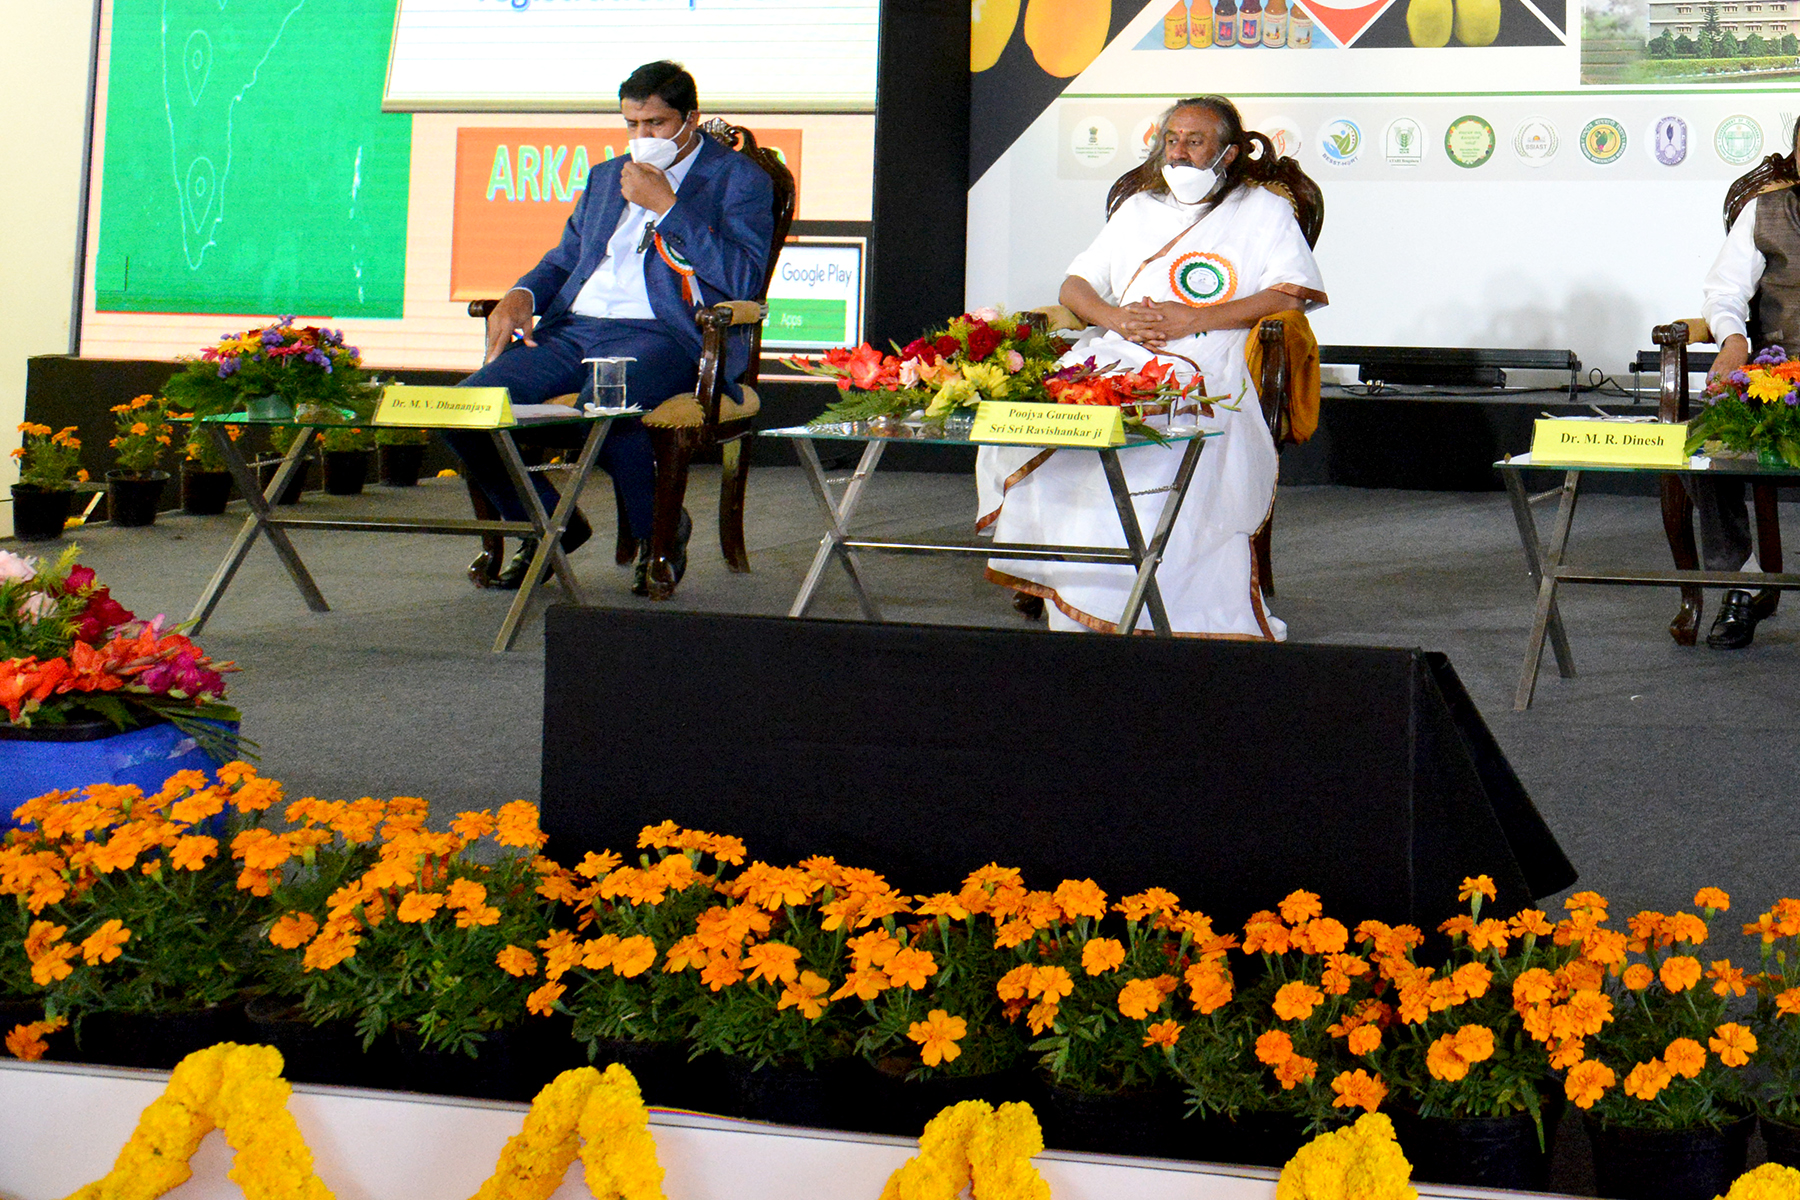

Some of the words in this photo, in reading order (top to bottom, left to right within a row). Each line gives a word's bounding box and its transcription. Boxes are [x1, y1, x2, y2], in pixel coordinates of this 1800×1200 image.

[486, 144, 588, 203] ARKA
[781, 261, 826, 284] Google
[827, 261, 853, 287] Play
[780, 312, 803, 328] Apps
[392, 399, 406, 408] Dr.
[410, 400, 421, 409] M.
[425, 400, 434, 409] V.
[436, 401, 492, 413] Dhananjaya
[1008, 408, 1043, 421] Poojya
[1046, 410, 1092, 421] Gurudev
[989, 424, 1005, 433] Sri
[1007, 425, 1023, 434] Sri
[1025, 425, 1092, 438] Ravishankar
[1093, 428, 1103, 440] ji
[1560, 432, 1580, 444] Dr.
[1584, 433, 1601, 445] M.
[1605, 434, 1618, 445] R.
[1622, 434, 1665, 446] Dinesh
